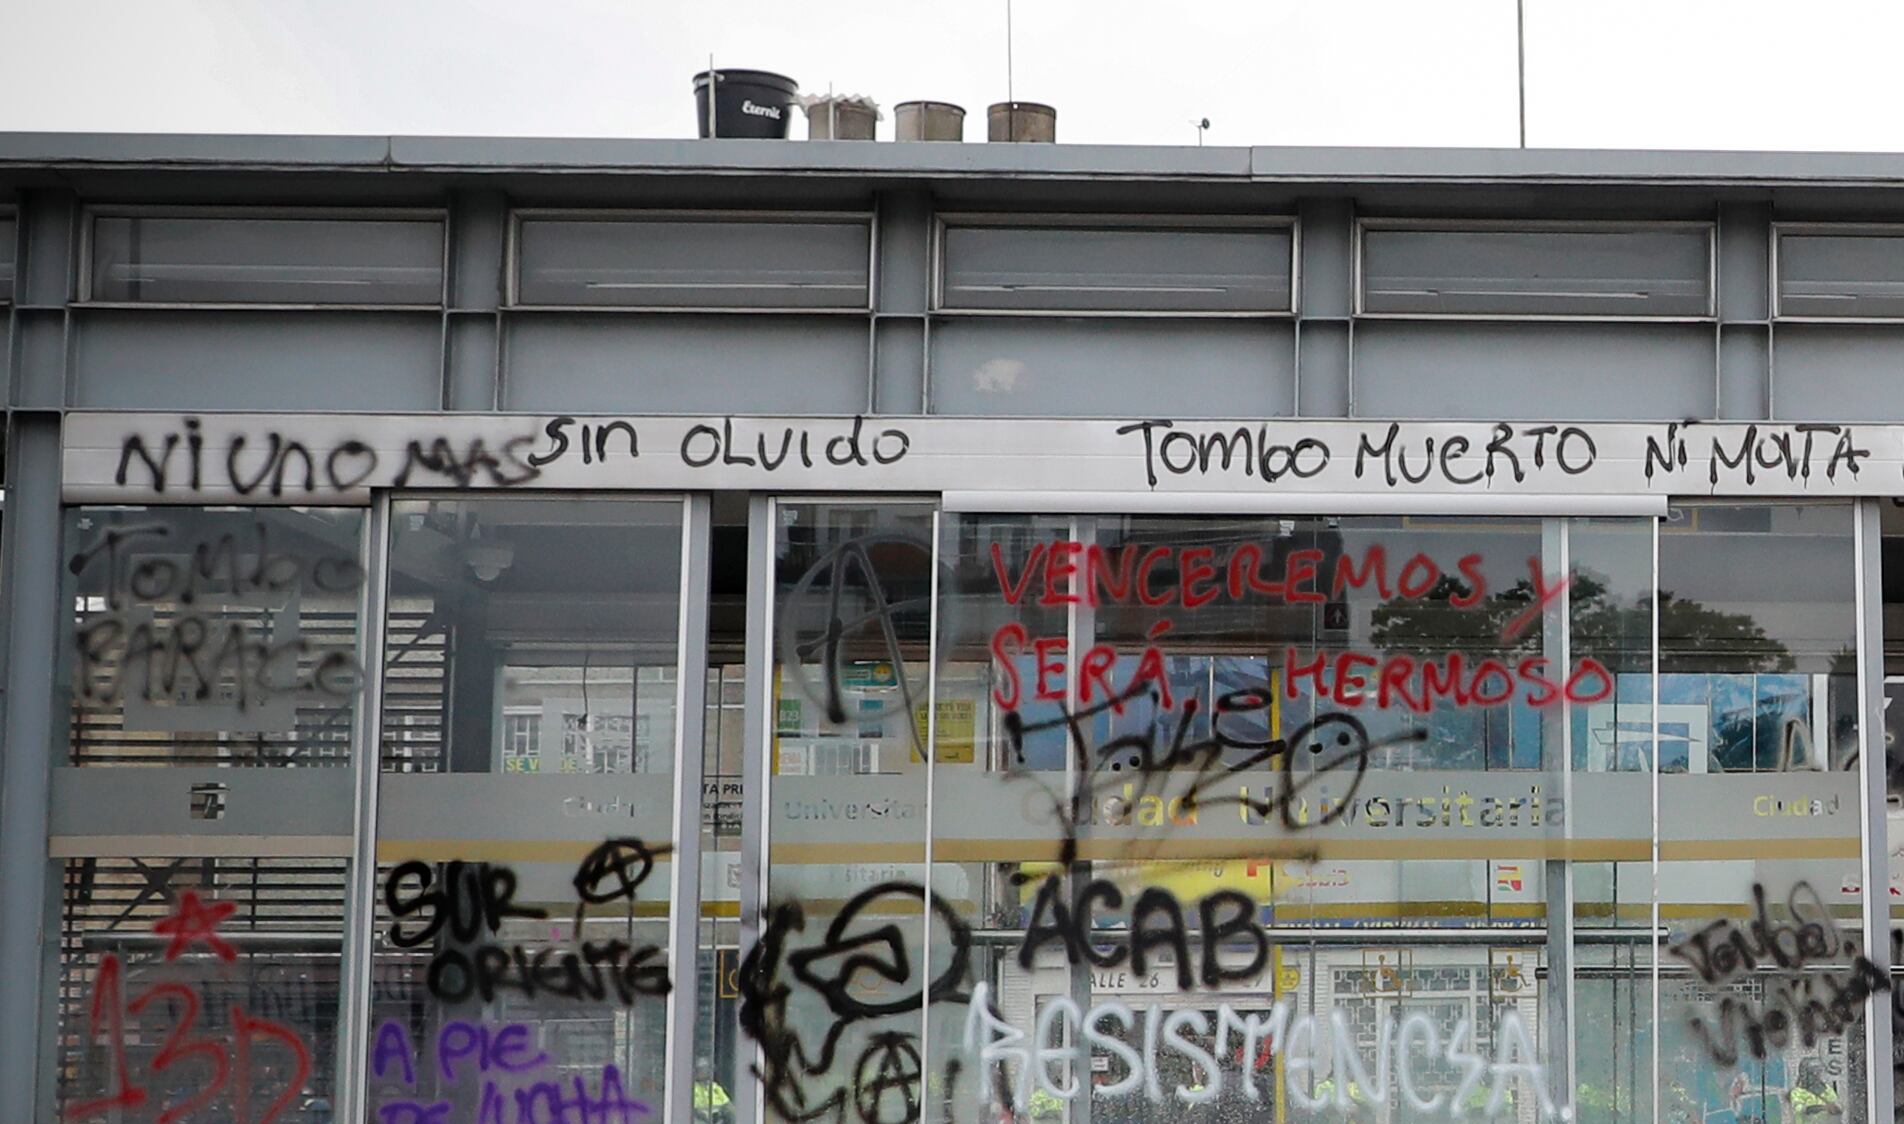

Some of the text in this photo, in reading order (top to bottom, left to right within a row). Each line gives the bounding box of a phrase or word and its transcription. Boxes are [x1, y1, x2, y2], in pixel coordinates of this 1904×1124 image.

[742, 99, 782, 120] Eternit
[990, 540, 1485, 609] VENCEREMOS
[1285, 647, 1614, 713] HERMOSO
[1753, 794, 1840, 817] Ciudad
[385, 859, 548, 948] SUR
[1017, 872, 1270, 991] ACAB
[425, 942, 673, 1007] ORIENTE
[374, 1020, 549, 1083] A PIE
